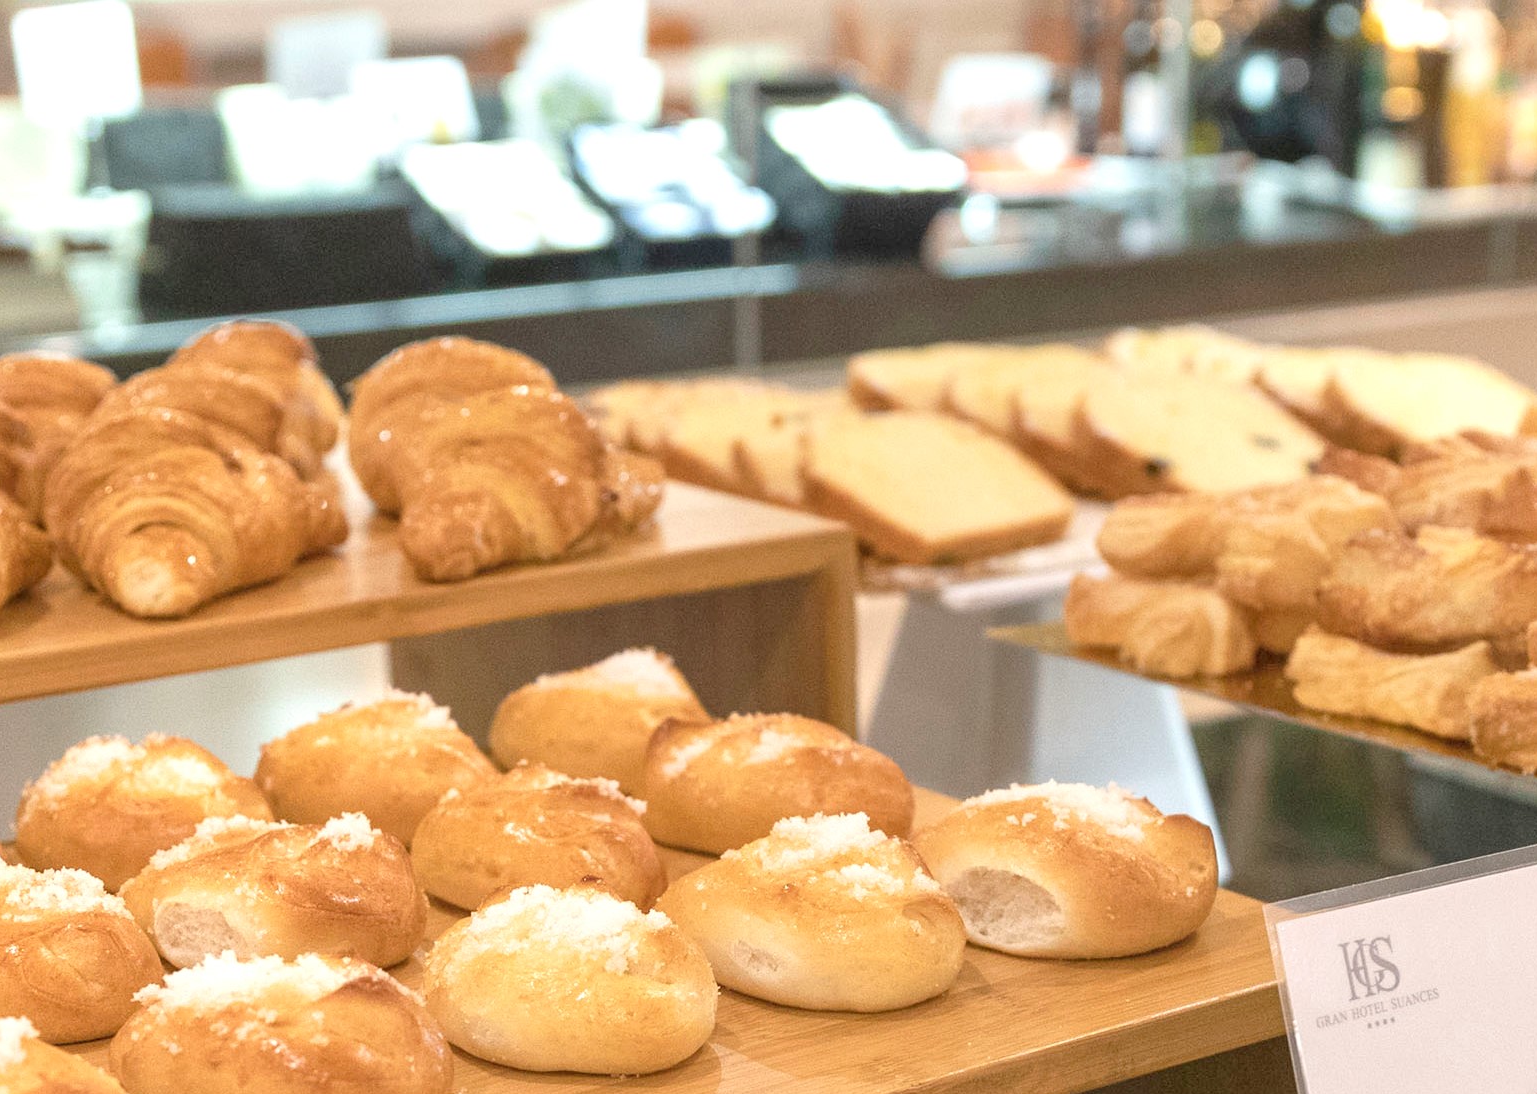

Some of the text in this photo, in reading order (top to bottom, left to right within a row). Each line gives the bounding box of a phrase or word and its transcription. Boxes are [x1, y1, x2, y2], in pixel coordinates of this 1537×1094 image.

[1316, 988, 1441, 1029] GRAN HOTEL SUANCES
